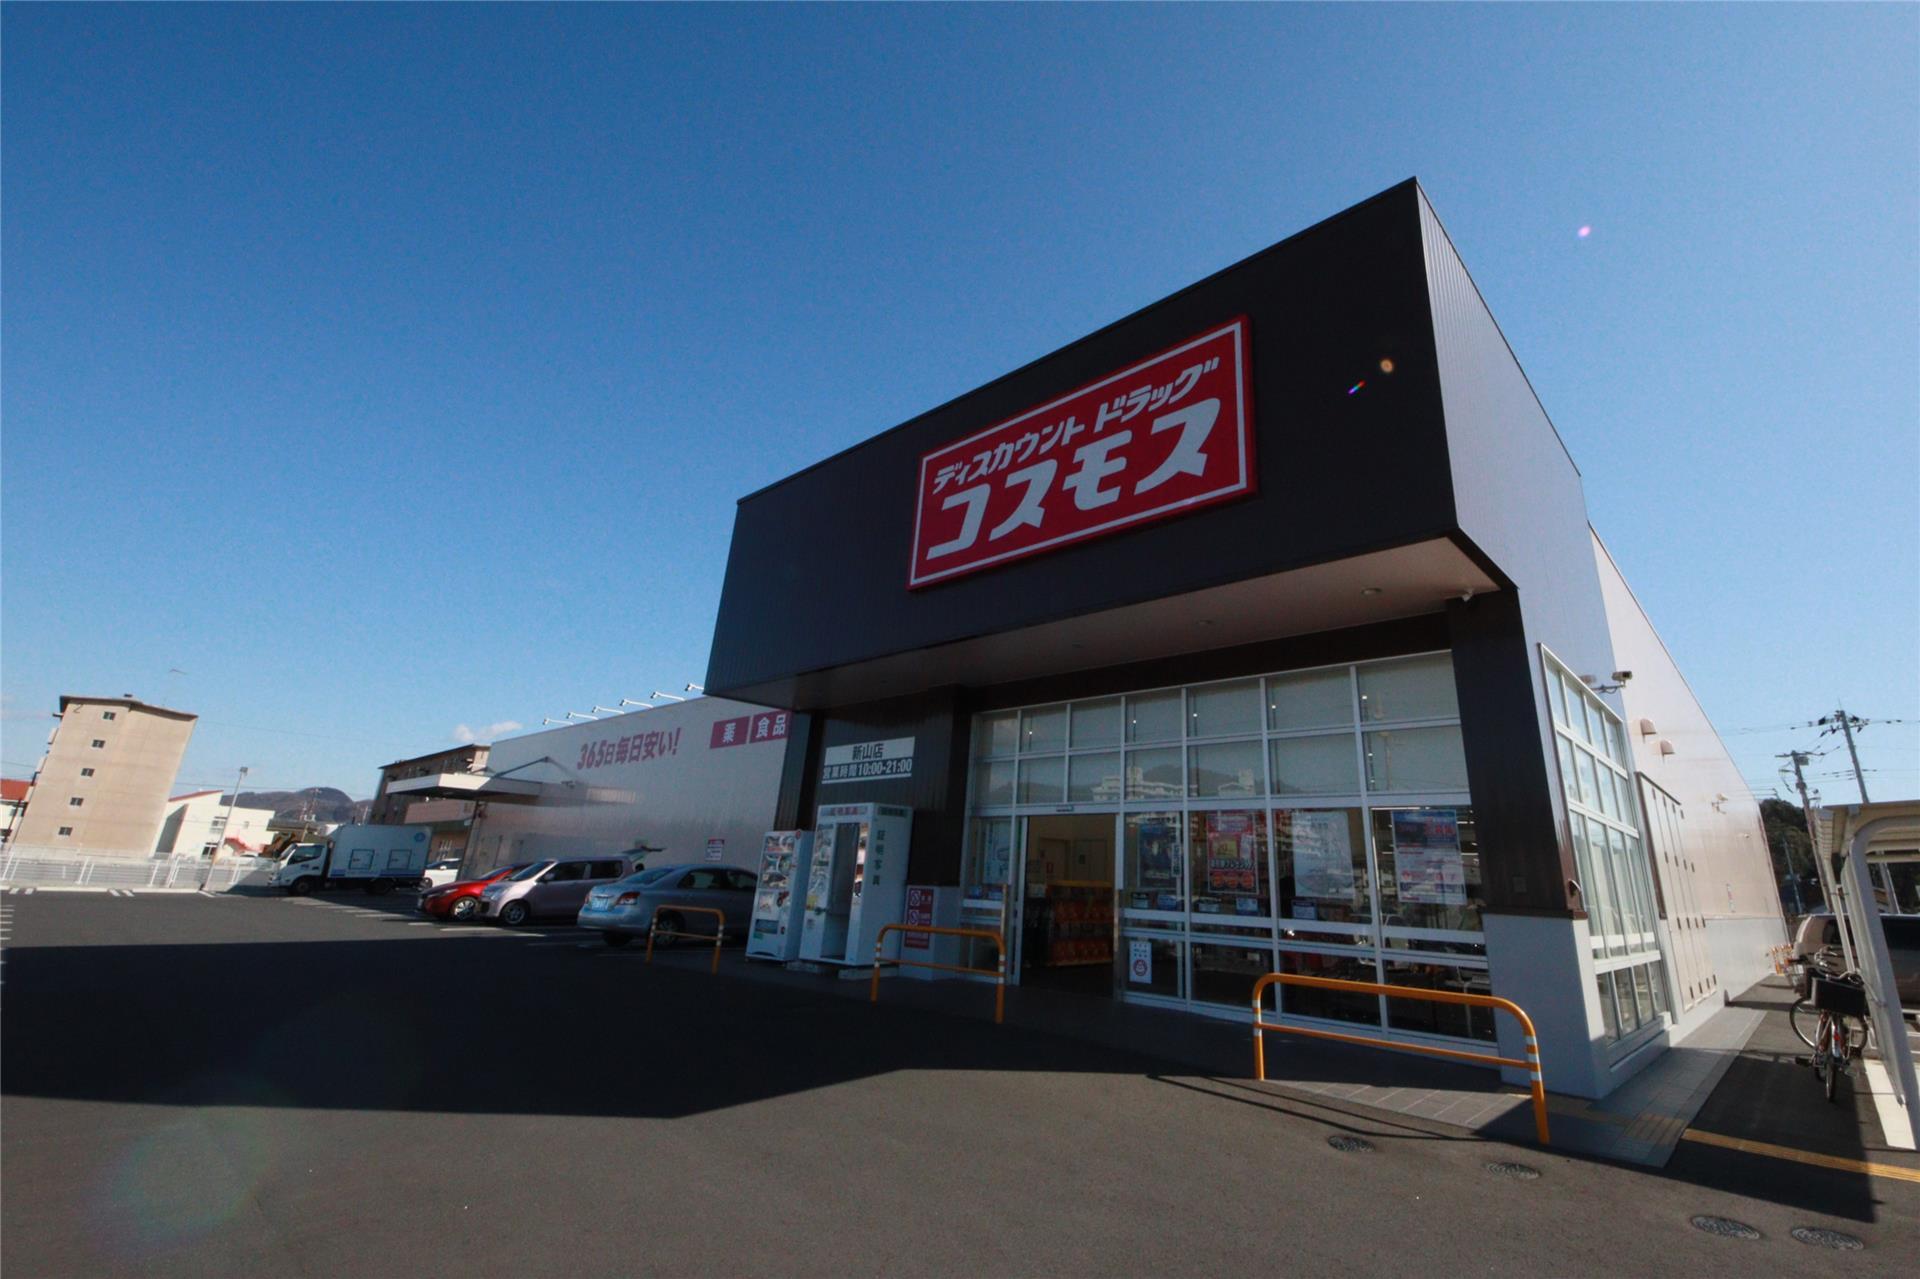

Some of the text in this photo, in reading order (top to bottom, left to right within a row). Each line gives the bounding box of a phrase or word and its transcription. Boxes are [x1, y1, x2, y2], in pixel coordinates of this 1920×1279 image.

[932, 357, 1220, 494] ディスカウント ドラッグ
[926, 398, 1221, 560] コスモス
[756, 714, 786, 738] 食品
[852, 743, 884, 760] 新山店
